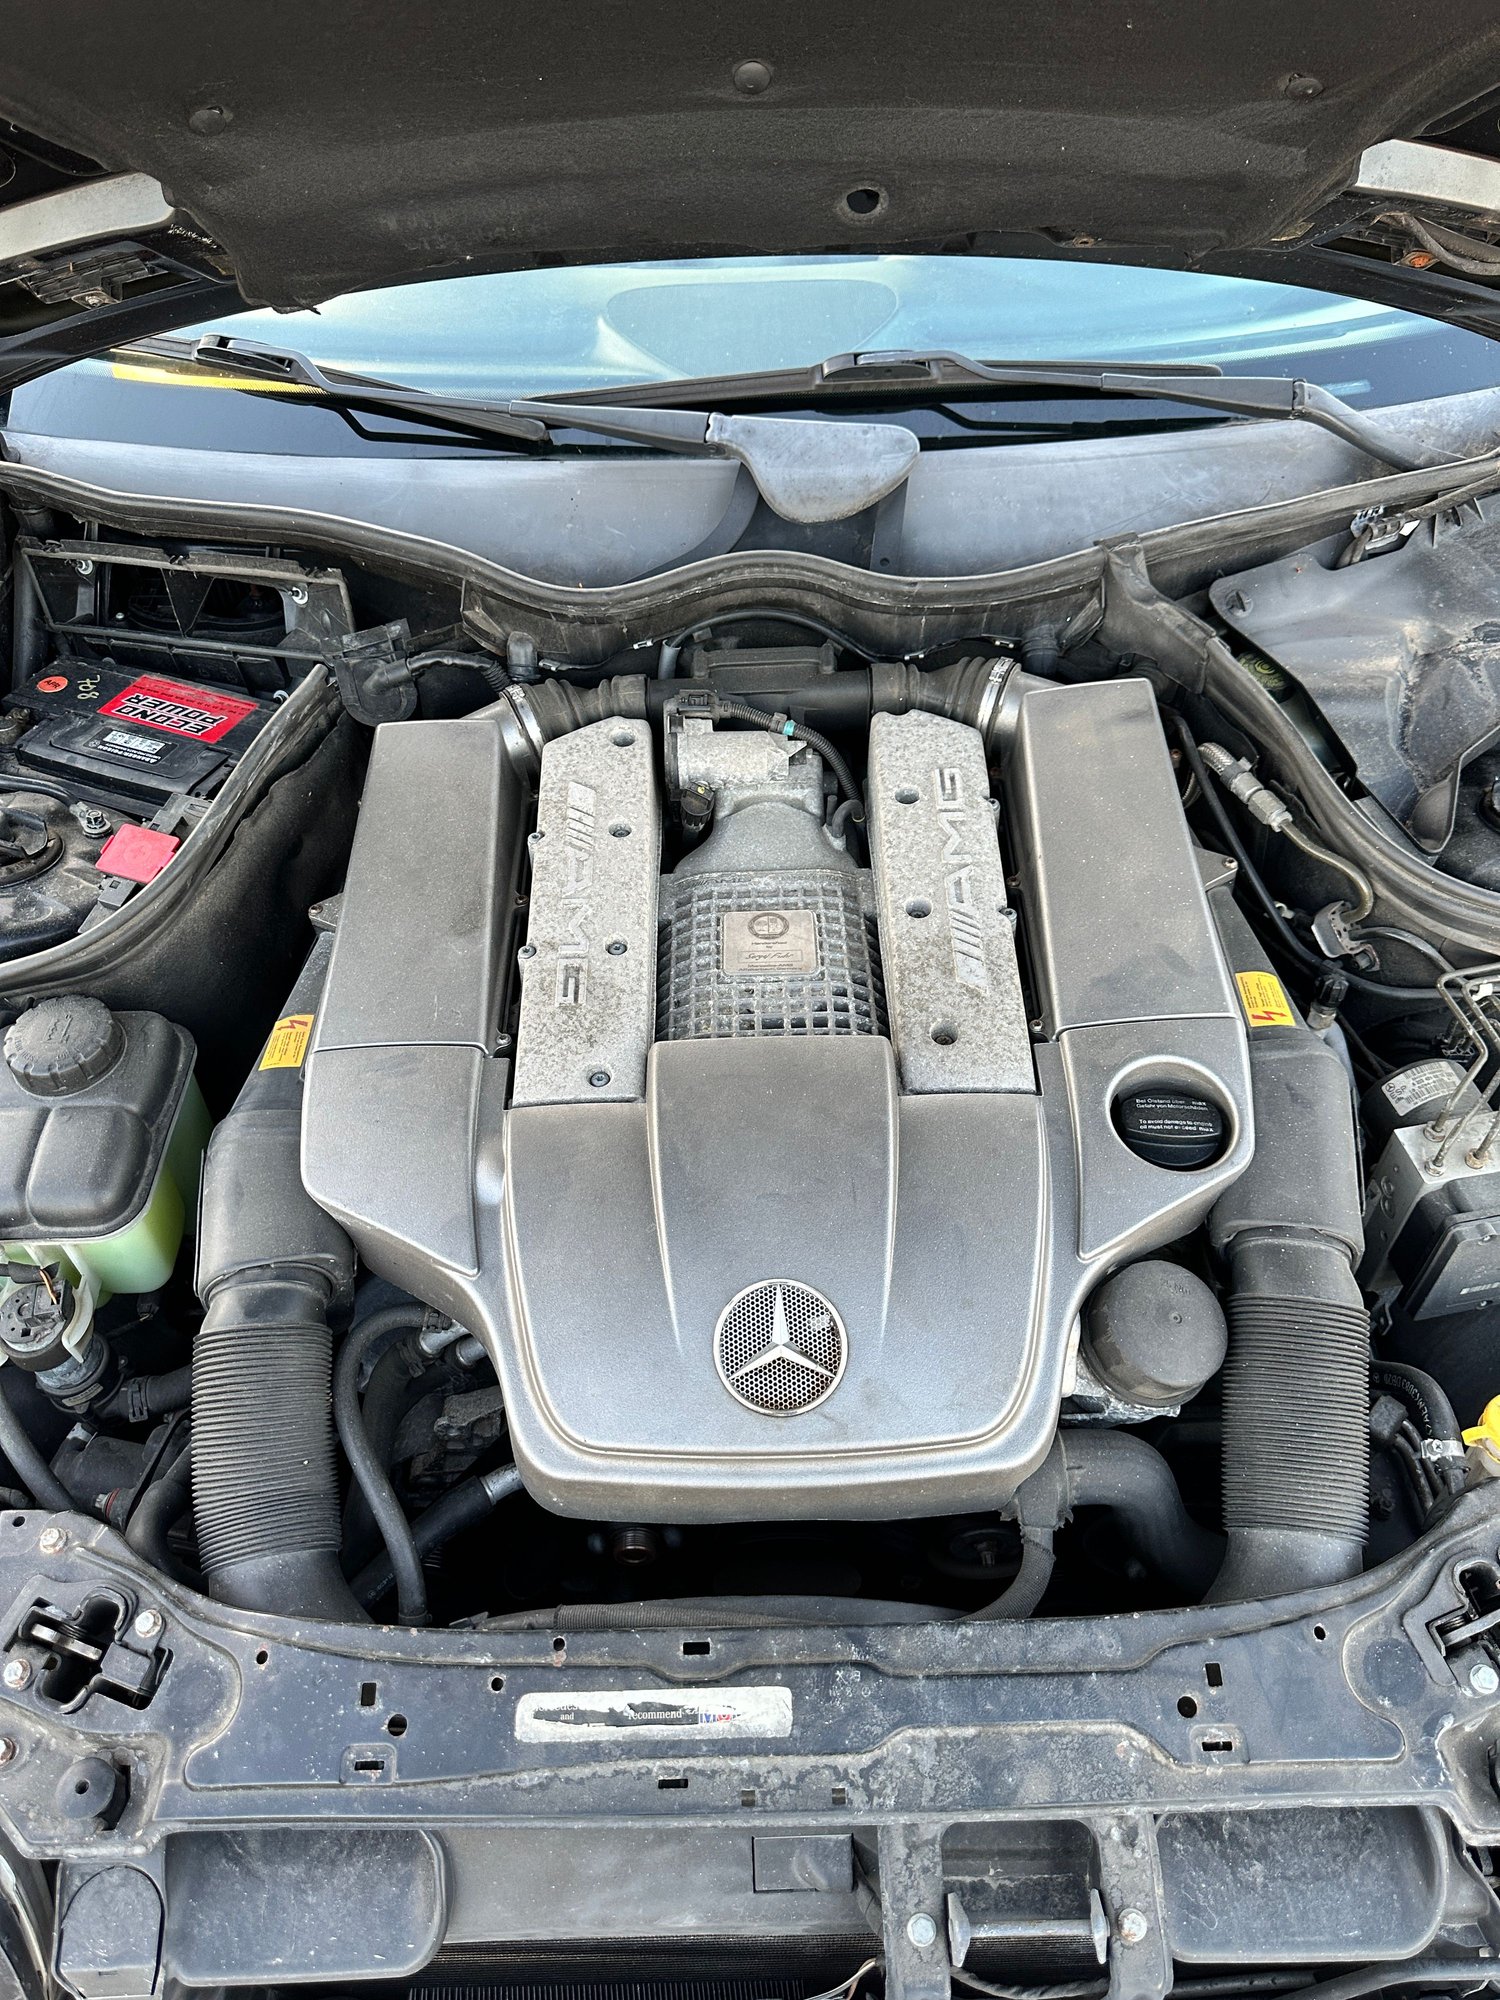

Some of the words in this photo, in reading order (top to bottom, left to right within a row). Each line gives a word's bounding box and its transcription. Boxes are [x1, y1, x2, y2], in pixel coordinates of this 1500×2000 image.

[111, 704, 213, 736] ECONO
[121, 693, 228, 726] POWER
[1390, 1085, 1407, 1100] ESP
[560, 1711, 574, 1721] and
[627, 1709, 683, 1720] recommend
